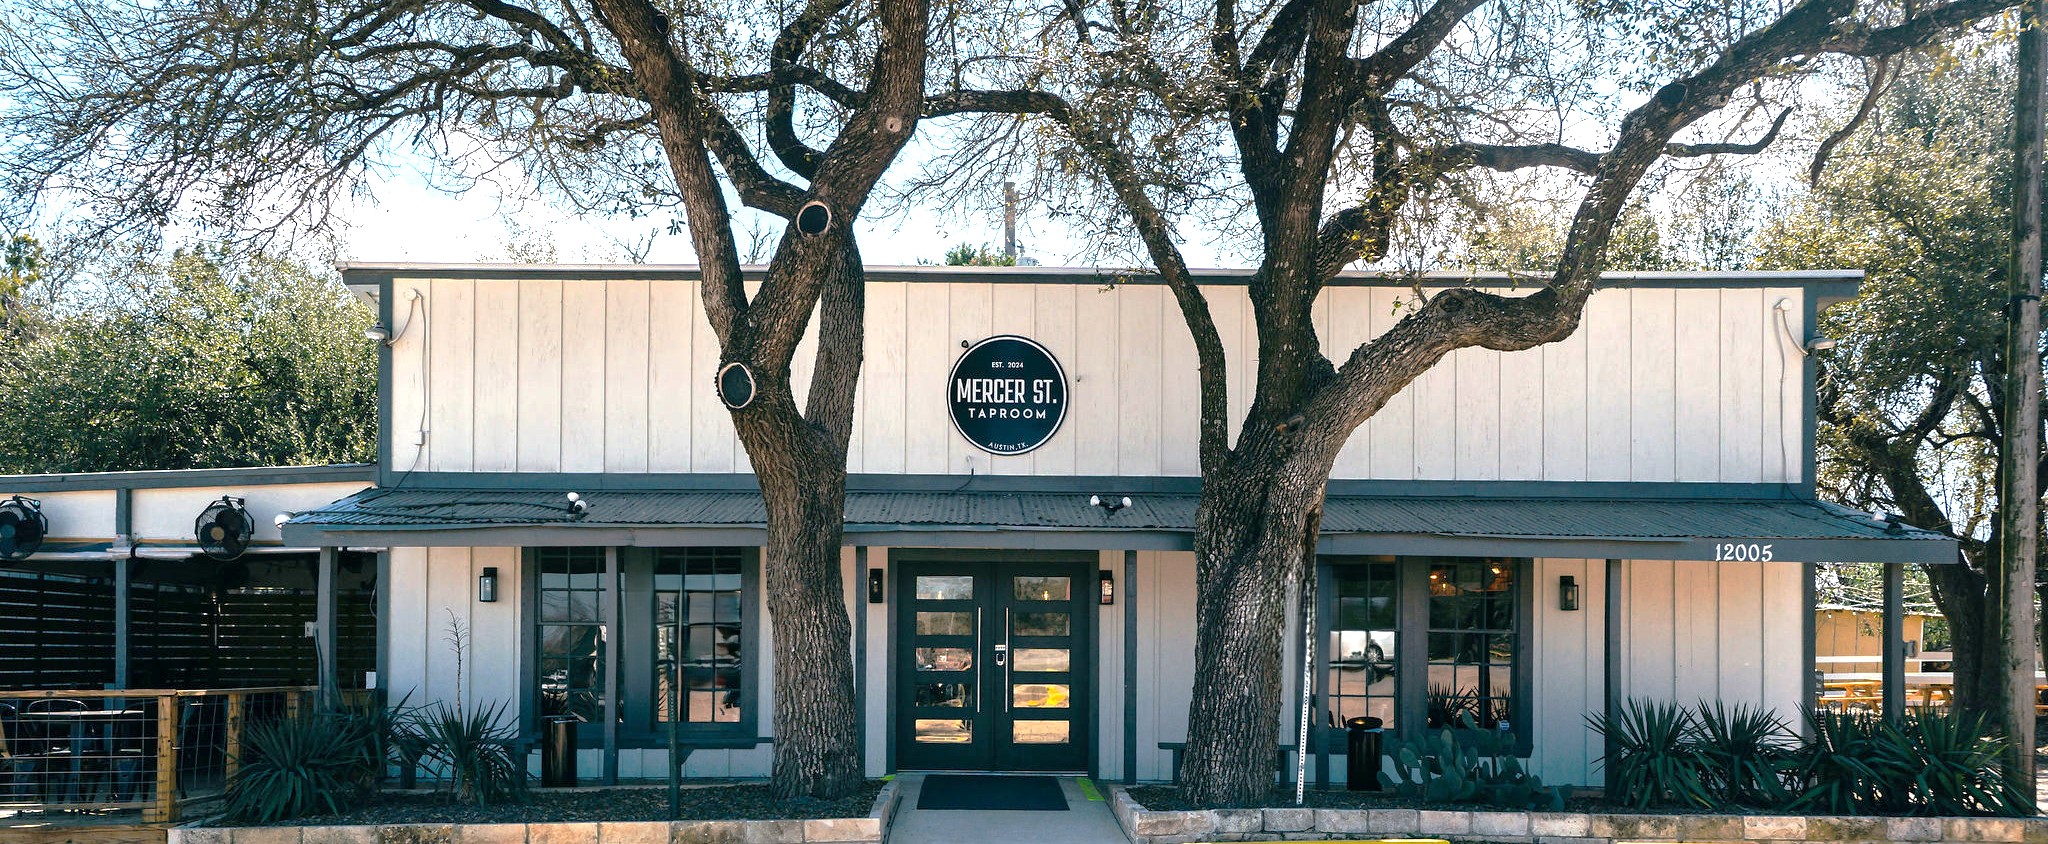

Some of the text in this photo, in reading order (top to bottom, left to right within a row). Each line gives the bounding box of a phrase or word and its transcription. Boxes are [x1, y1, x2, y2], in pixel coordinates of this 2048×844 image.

[1007, 361, 1024, 369] 2024
[957, 378, 1057, 404] MERCER ST.
[968, 407, 1046, 419] TAPROOM
[1715, 543, 1773, 562] 12005
